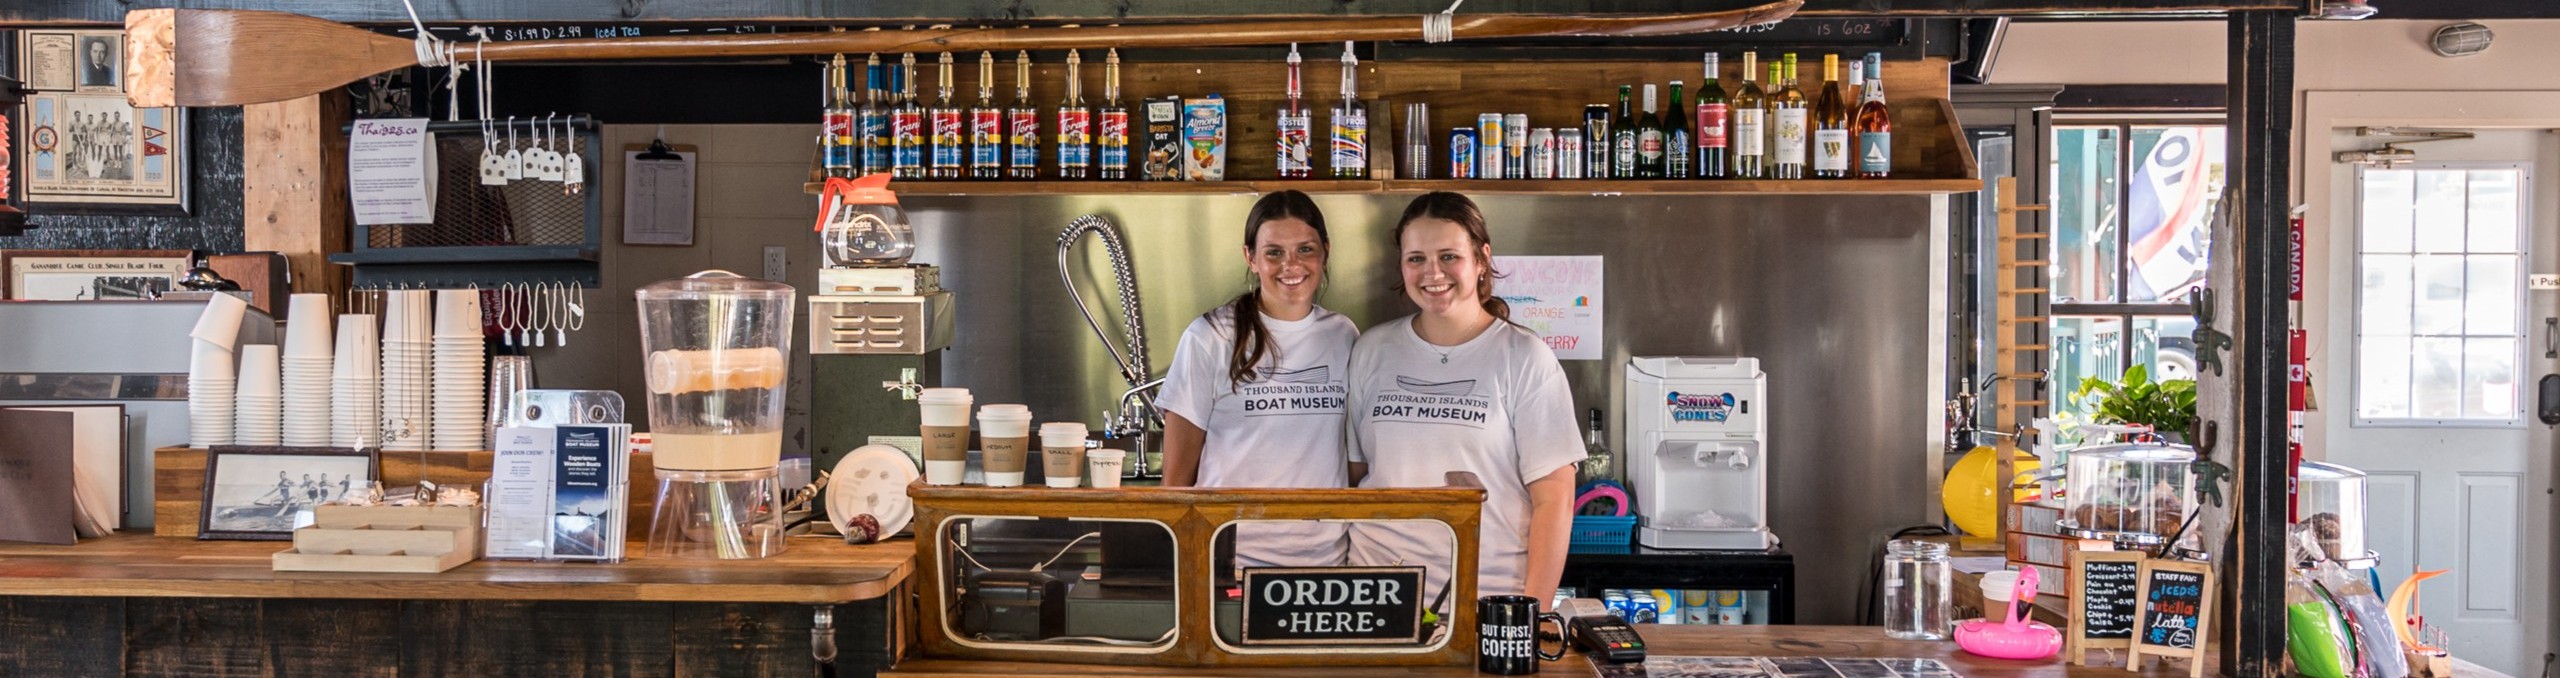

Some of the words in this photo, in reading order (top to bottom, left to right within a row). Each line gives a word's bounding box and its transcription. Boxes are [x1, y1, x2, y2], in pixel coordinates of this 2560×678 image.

[558, 26, 582, 38] 2.99
[595, 26, 617, 38] Iced
[621, 26, 641, 37] Tea
[1060, 117, 1089, 134] Torani
[1100, 118, 1128, 137] Torani
[1186, 115, 1221, 128] Almond
[358, 122, 418, 136] Thai925.ca
[2291, 230, 2301, 293] CANADA
[1522, 307, 1566, 319] ORANGE
[1542, 335, 1580, 350] ERRY
[1244, 385, 1302, 396] THOUSAND
[1304, 385, 1345, 395] ISLANDS
[1244, 398, 1287, 411] BOAT
[1290, 397, 1346, 410] MUSEUM
[1377, 394, 1436, 405] THOUSAND
[1438, 396, 1489, 409] ISLANDS
[1676, 394, 1724, 409] SNOW
[1372, 405, 1411, 417] BOAT
[1416, 406, 1487, 424] MUSEUM
[1673, 409, 1726, 422] CONES
[986, 443, 1013, 451] MEDIUM
[2154, 572, 2179, 581] STAFF
[1263, 579, 1402, 605] ORDER
[2161, 583, 2187, 596] ICED
[2086, 595, 2108, 604] Maple
[2147, 600, 2194, 616] nutella
[1289, 611, 1374, 633] HERE
[1482, 623, 1499, 636] BUT
[1501, 625, 1532, 640] FIRST,
[1481, 638, 1533, 658] COFFEE
